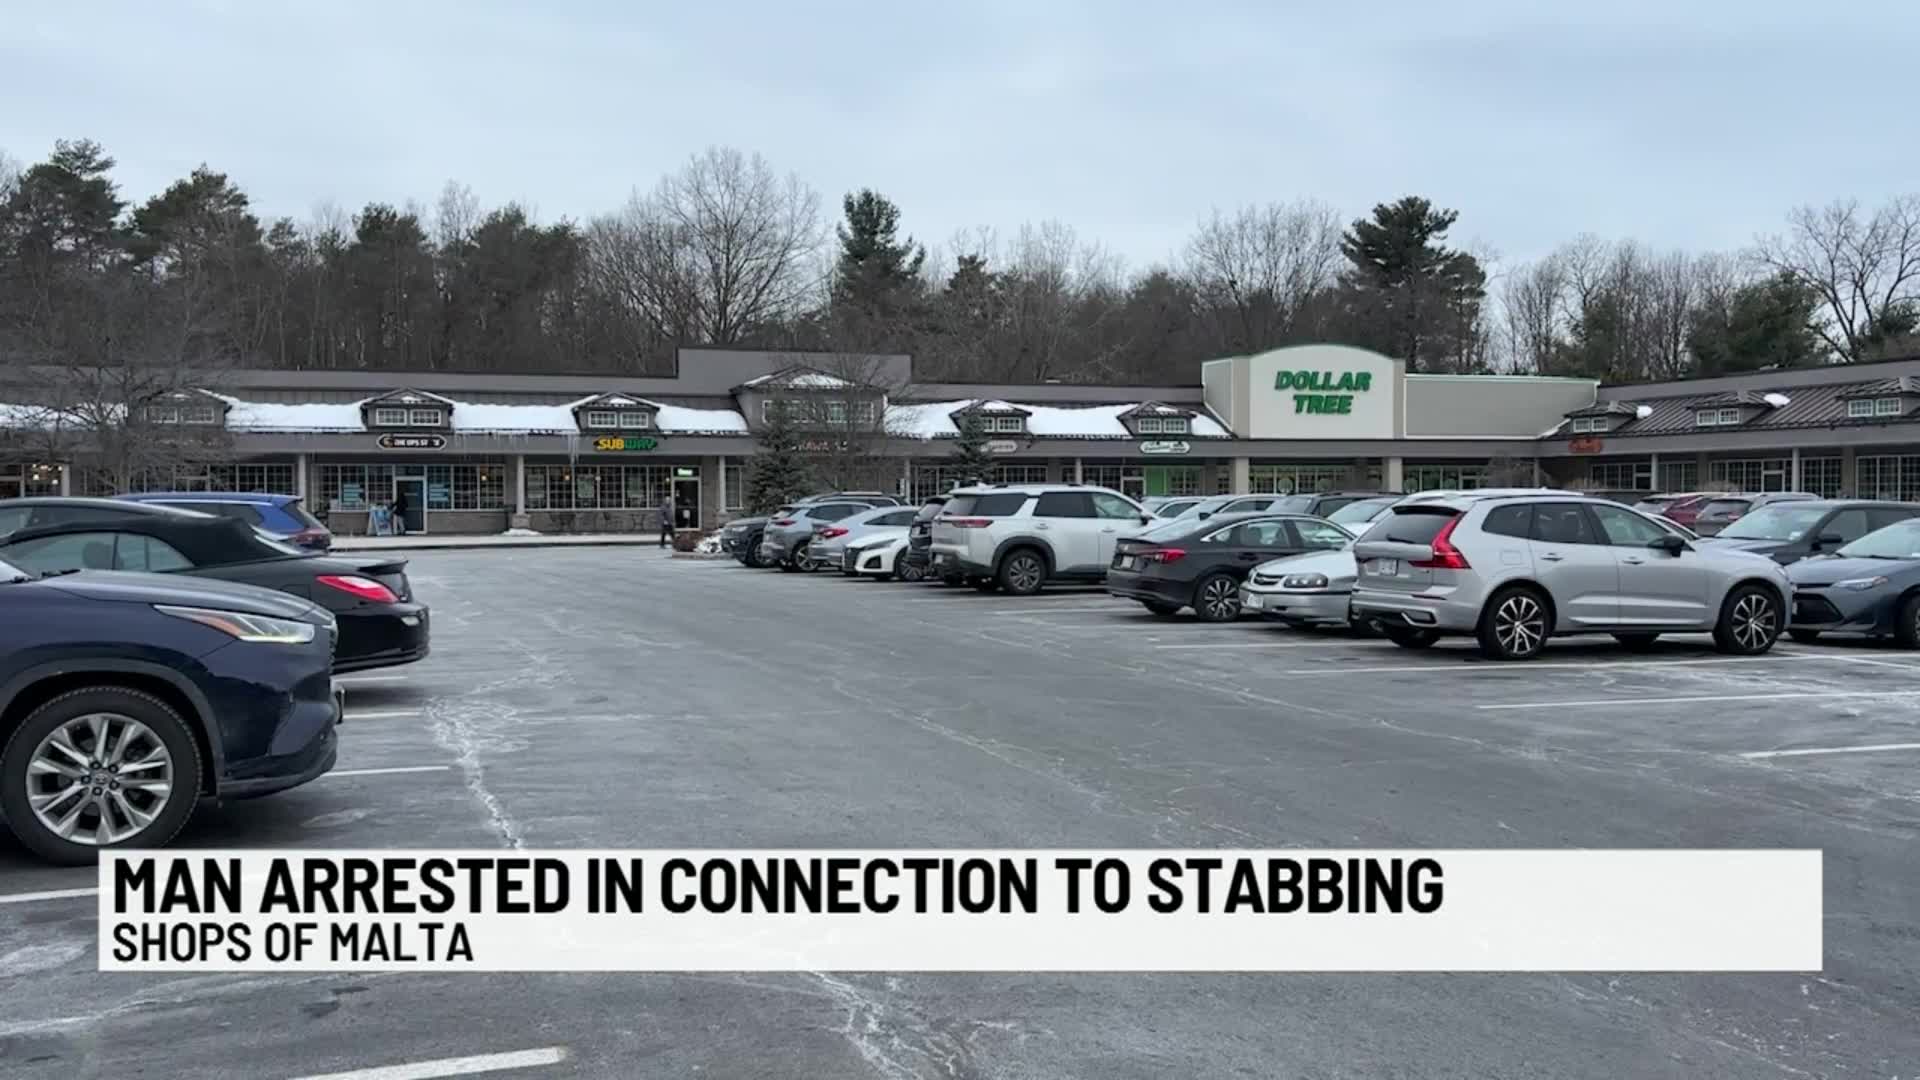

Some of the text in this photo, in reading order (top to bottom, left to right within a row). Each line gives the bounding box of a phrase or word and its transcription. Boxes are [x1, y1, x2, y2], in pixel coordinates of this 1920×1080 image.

[1275, 370, 1372, 392] DOLLAR
[1293, 394, 1354, 414] TREE
[597, 438, 656, 450] SUBWAY
